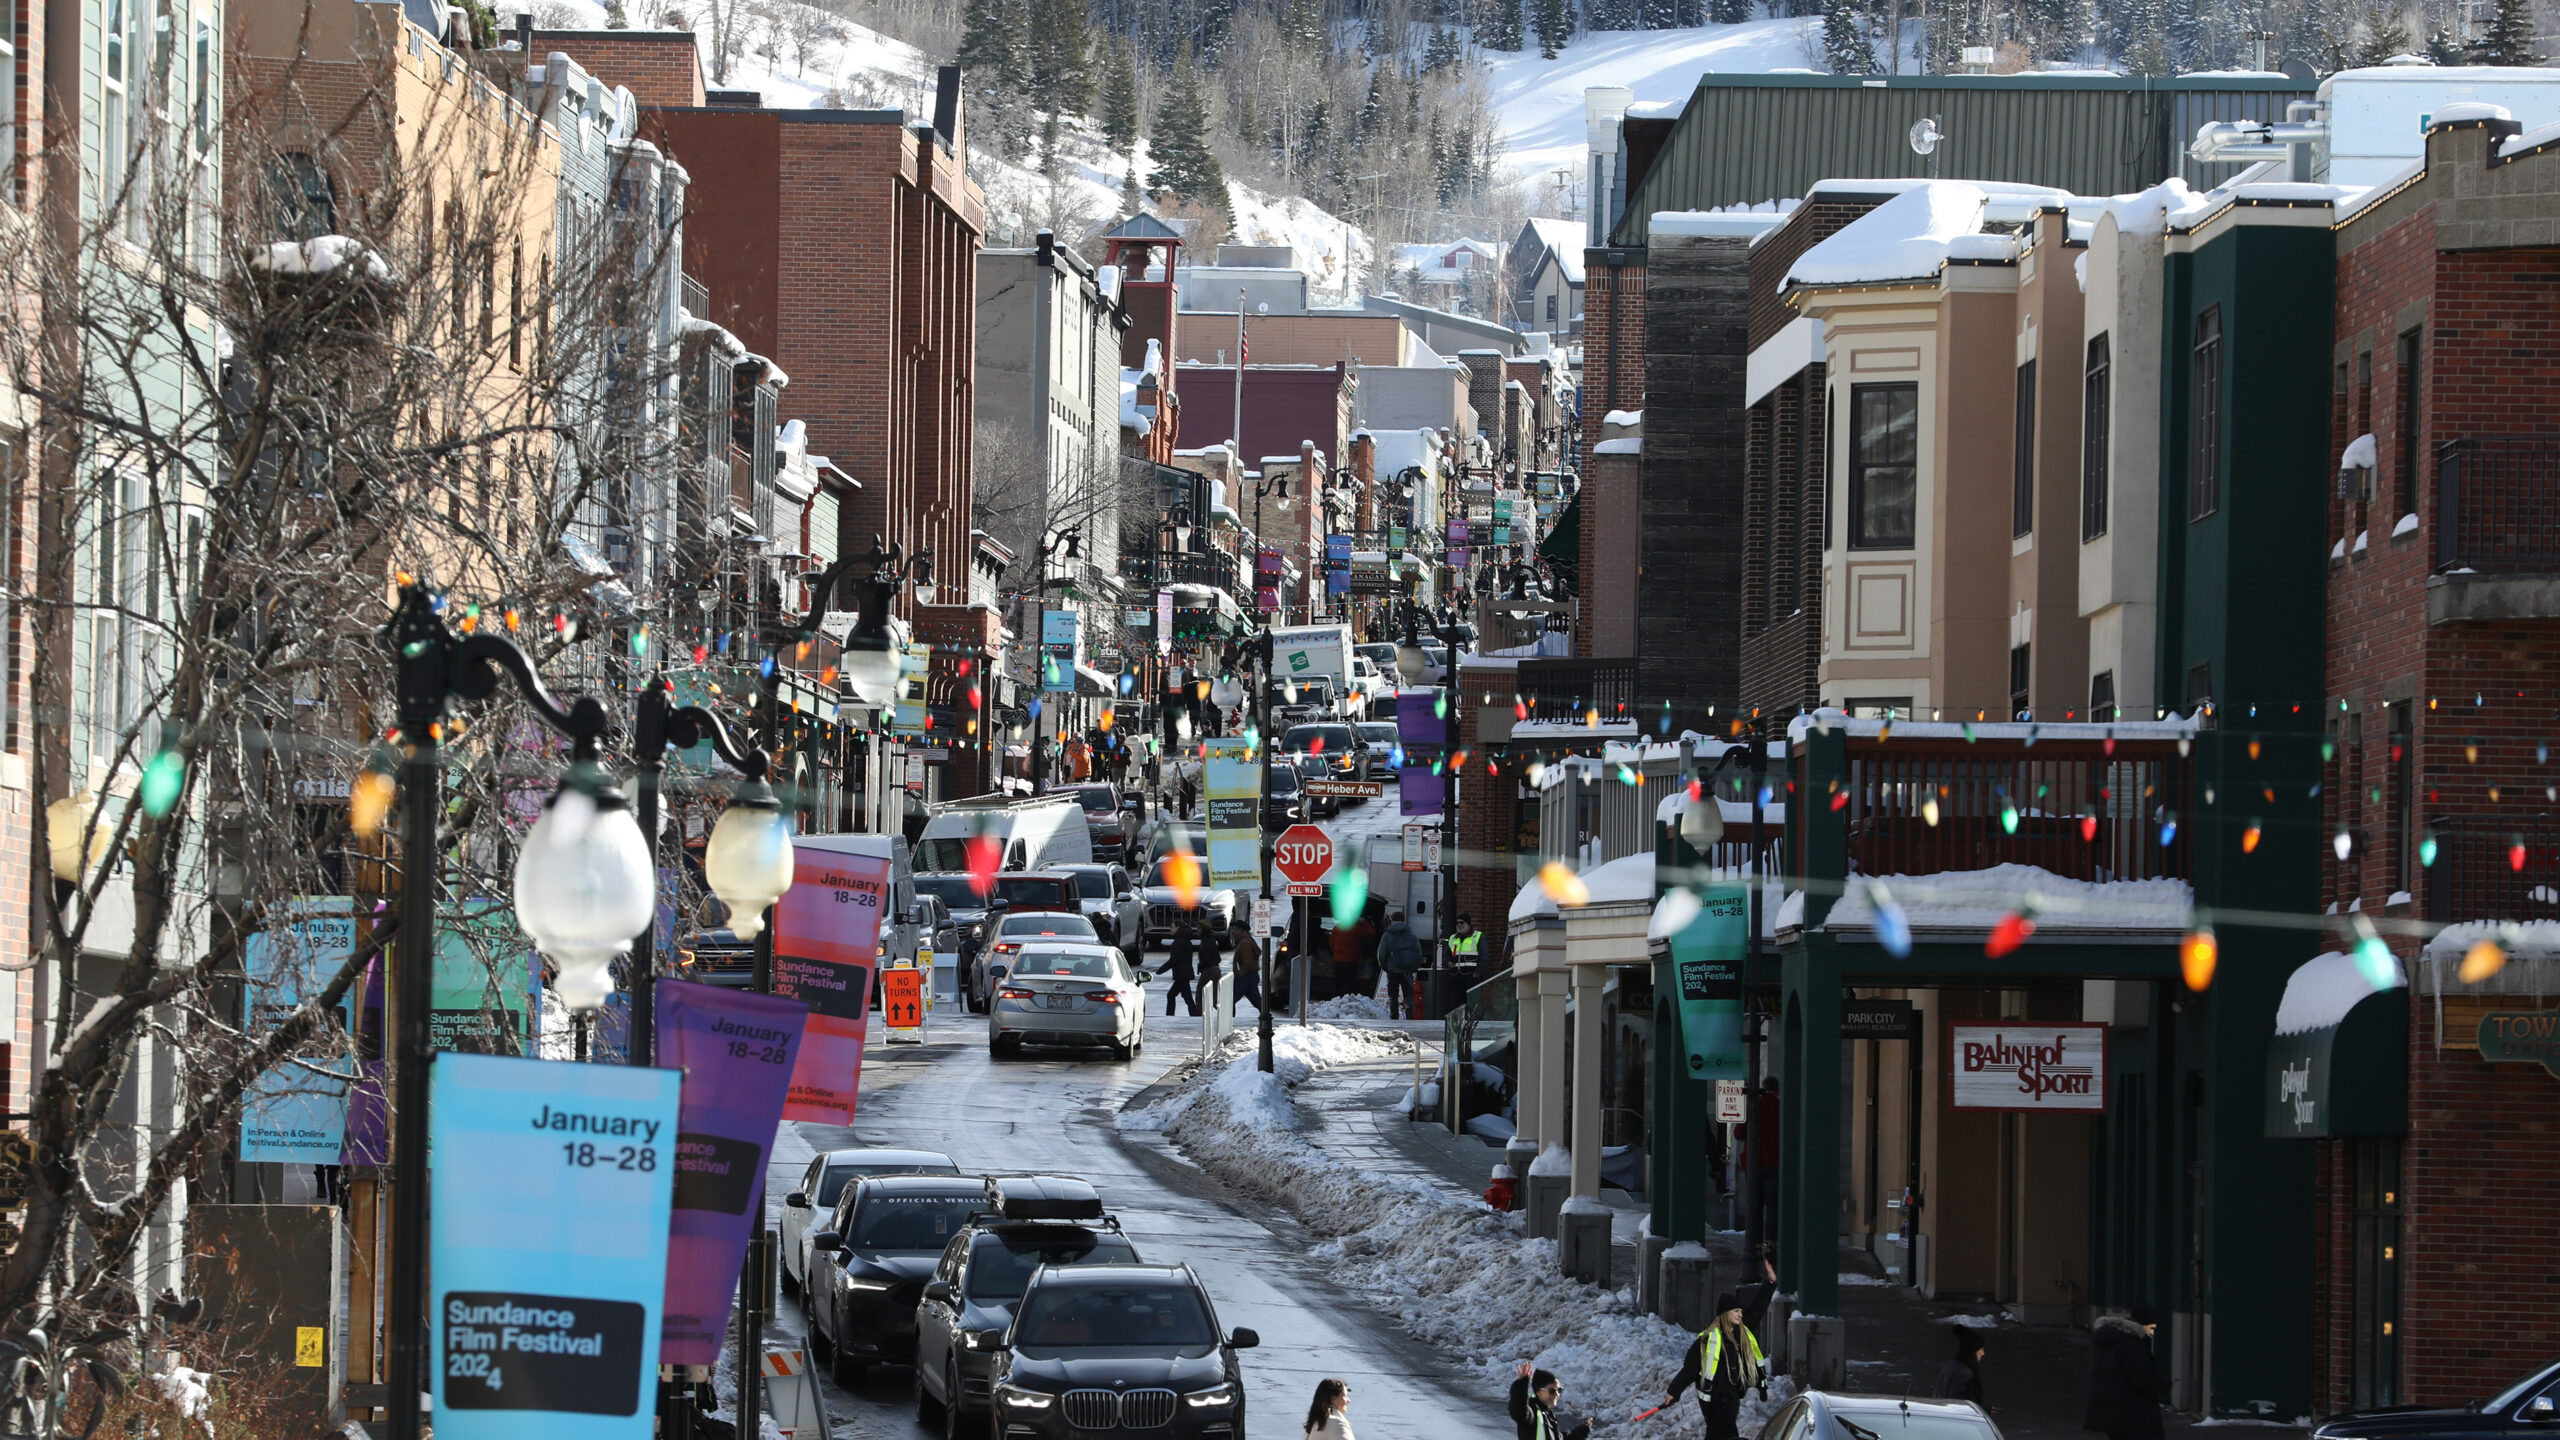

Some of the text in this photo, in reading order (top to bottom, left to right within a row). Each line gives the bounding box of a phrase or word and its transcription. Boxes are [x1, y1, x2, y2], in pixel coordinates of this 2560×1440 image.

[1100, 647, 1119, 656] stio
[1326, 784, 1379, 795] Heber Ave.
[1211, 814, 1228, 825] 2024
[1279, 843, 1330, 865] STOP
[821, 872, 880, 894] January
[1289, 886, 1319, 894] ALL WAY
[1700, 897, 1743, 908] January
[291, 921, 350, 936] January
[777, 959, 835, 977] Sundance
[1682, 963, 1726, 974] Sundance
[777, 972, 847, 991] Film Festival
[897, 977, 909, 986] NO
[1684, 971, 1736, 982] Film Festival
[889, 988, 918, 998] TURNS
[1685, 981, 1707, 993] 2024
[1847, 1013, 1896, 1024] PARK CITY
[430, 1025, 501, 1036] Film Festival
[711, 1016, 793, 1048] January
[2492, 1016, 2560, 1039] TOW
[430, 1037, 458, 1052] 2024
[804, 1086, 834, 1098] Online
[532, 1105, 661, 1143] January
[247, 1128, 326, 1139] In Person & Online
[247, 1138, 339, 1150] festival.sundance.org
[562, 1142, 657, 1173] 18–28
[448, 1300, 576, 1329] Sundance
[448, 1327, 603, 1357] Film Festival
[448, 1354, 503, 1391] 2024
